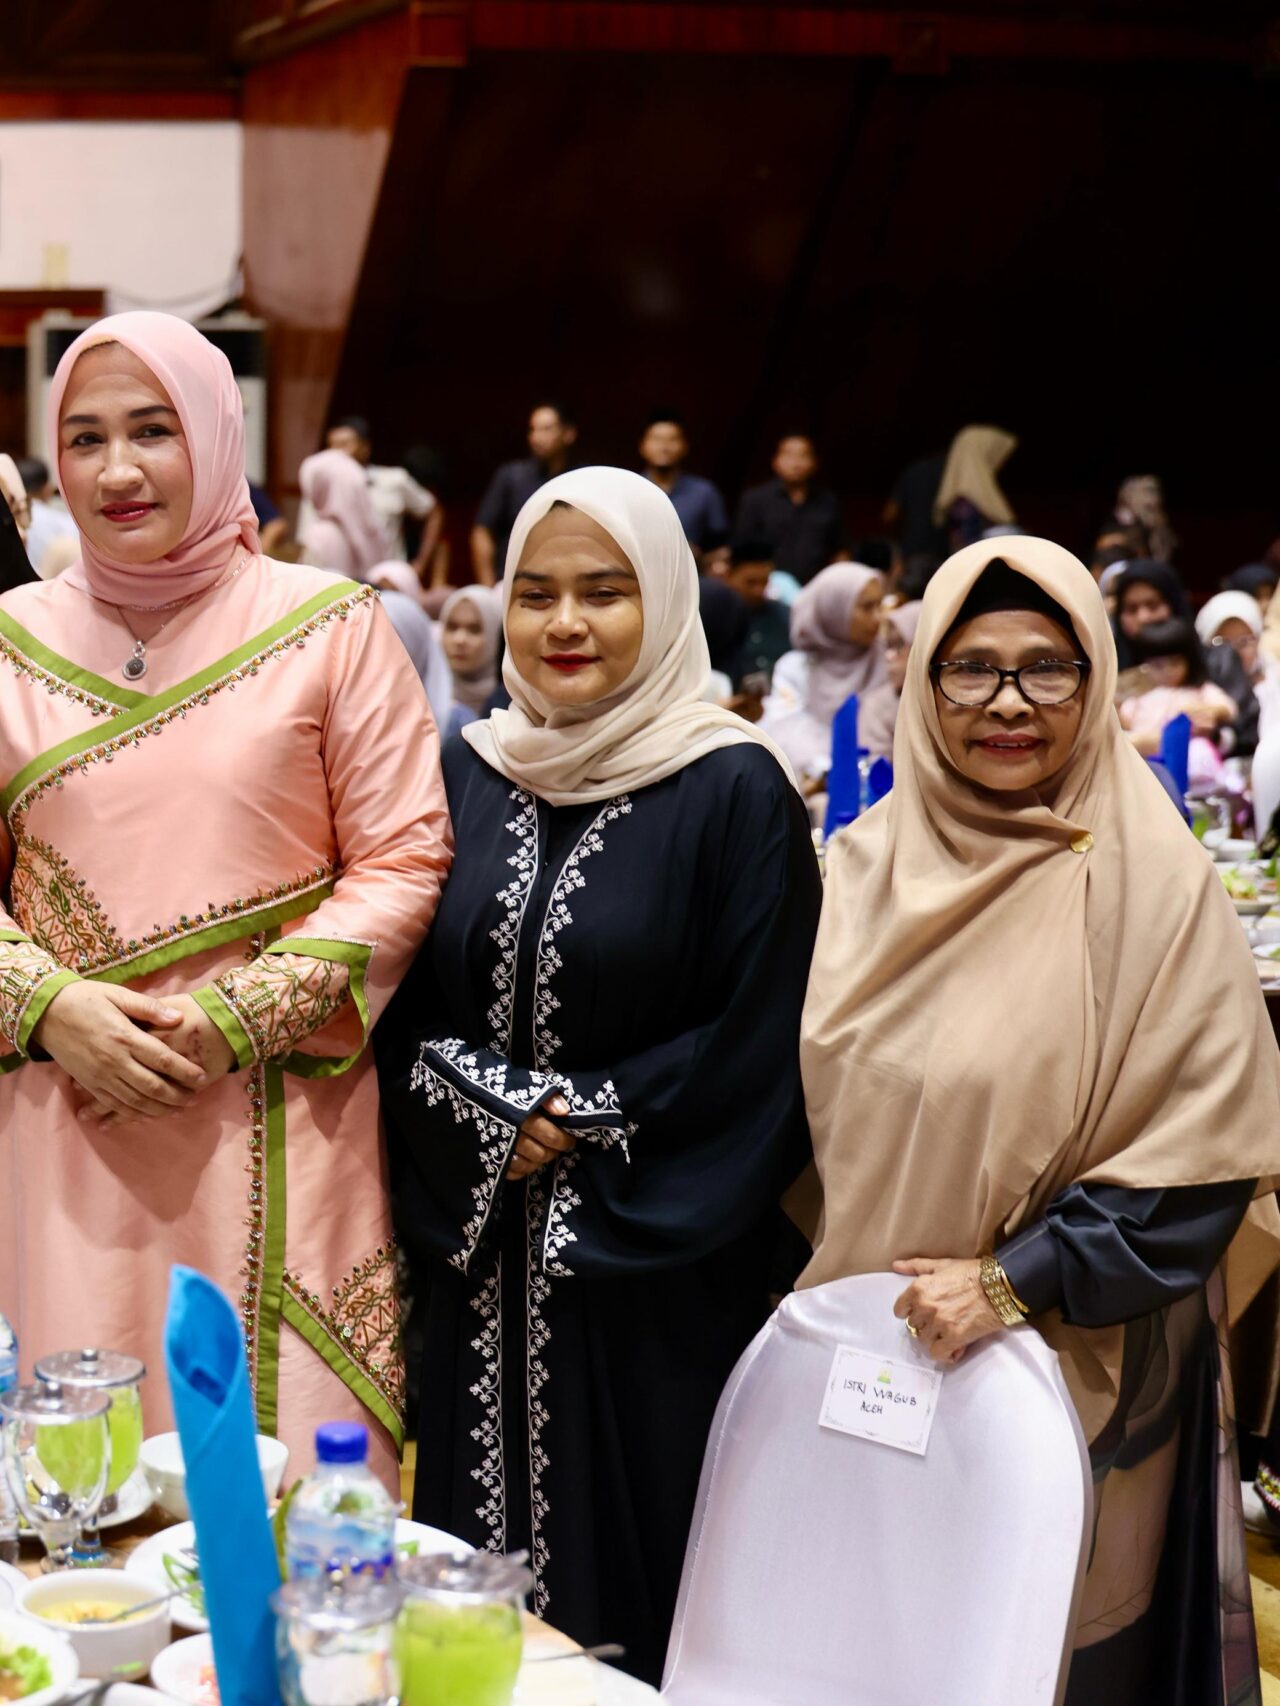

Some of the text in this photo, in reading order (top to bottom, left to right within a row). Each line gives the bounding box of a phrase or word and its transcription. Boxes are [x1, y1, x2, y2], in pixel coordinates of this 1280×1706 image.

[843, 1378, 917, 1406] ISTRI WAGUB
[860, 1400, 884, 1414] ACEH
